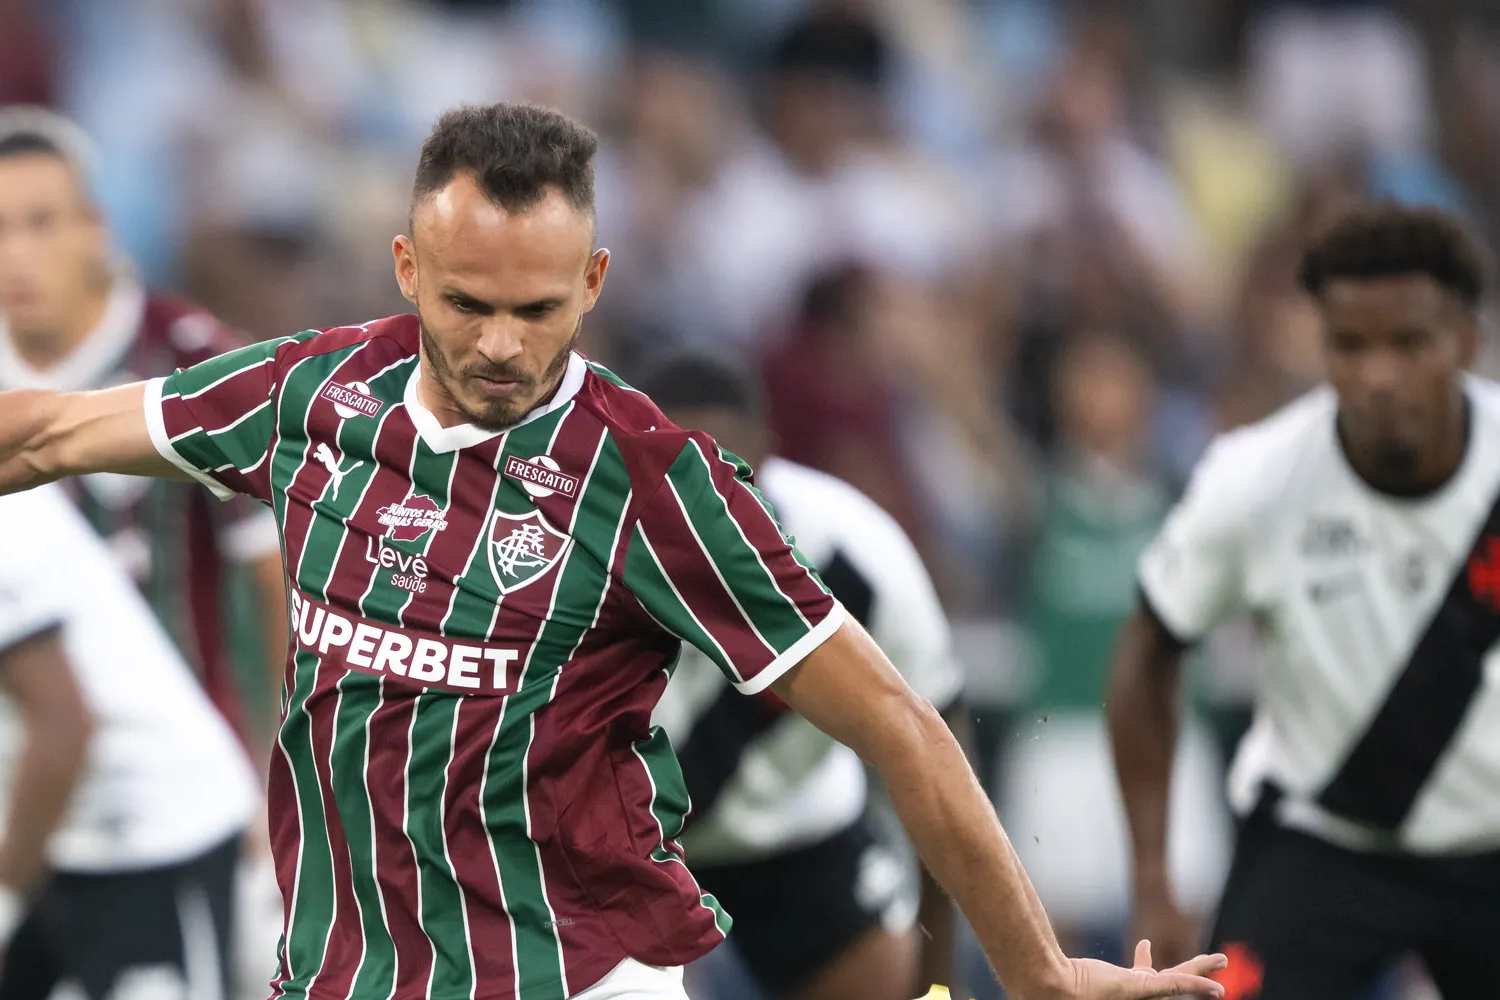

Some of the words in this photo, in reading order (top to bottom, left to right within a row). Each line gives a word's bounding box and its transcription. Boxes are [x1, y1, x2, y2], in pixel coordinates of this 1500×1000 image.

[325, 385, 378, 414] FRESCATTO
[508, 460, 574, 493] FRESCATTO
[379, 513, 413, 526] MINAS
[413, 518, 448, 531] GERAIS
[388, 504, 424, 517] JUNTOS
[424, 510, 446, 520] POR
[390, 573, 426, 593] saúde
[292, 588, 518, 689] SUPERBET
